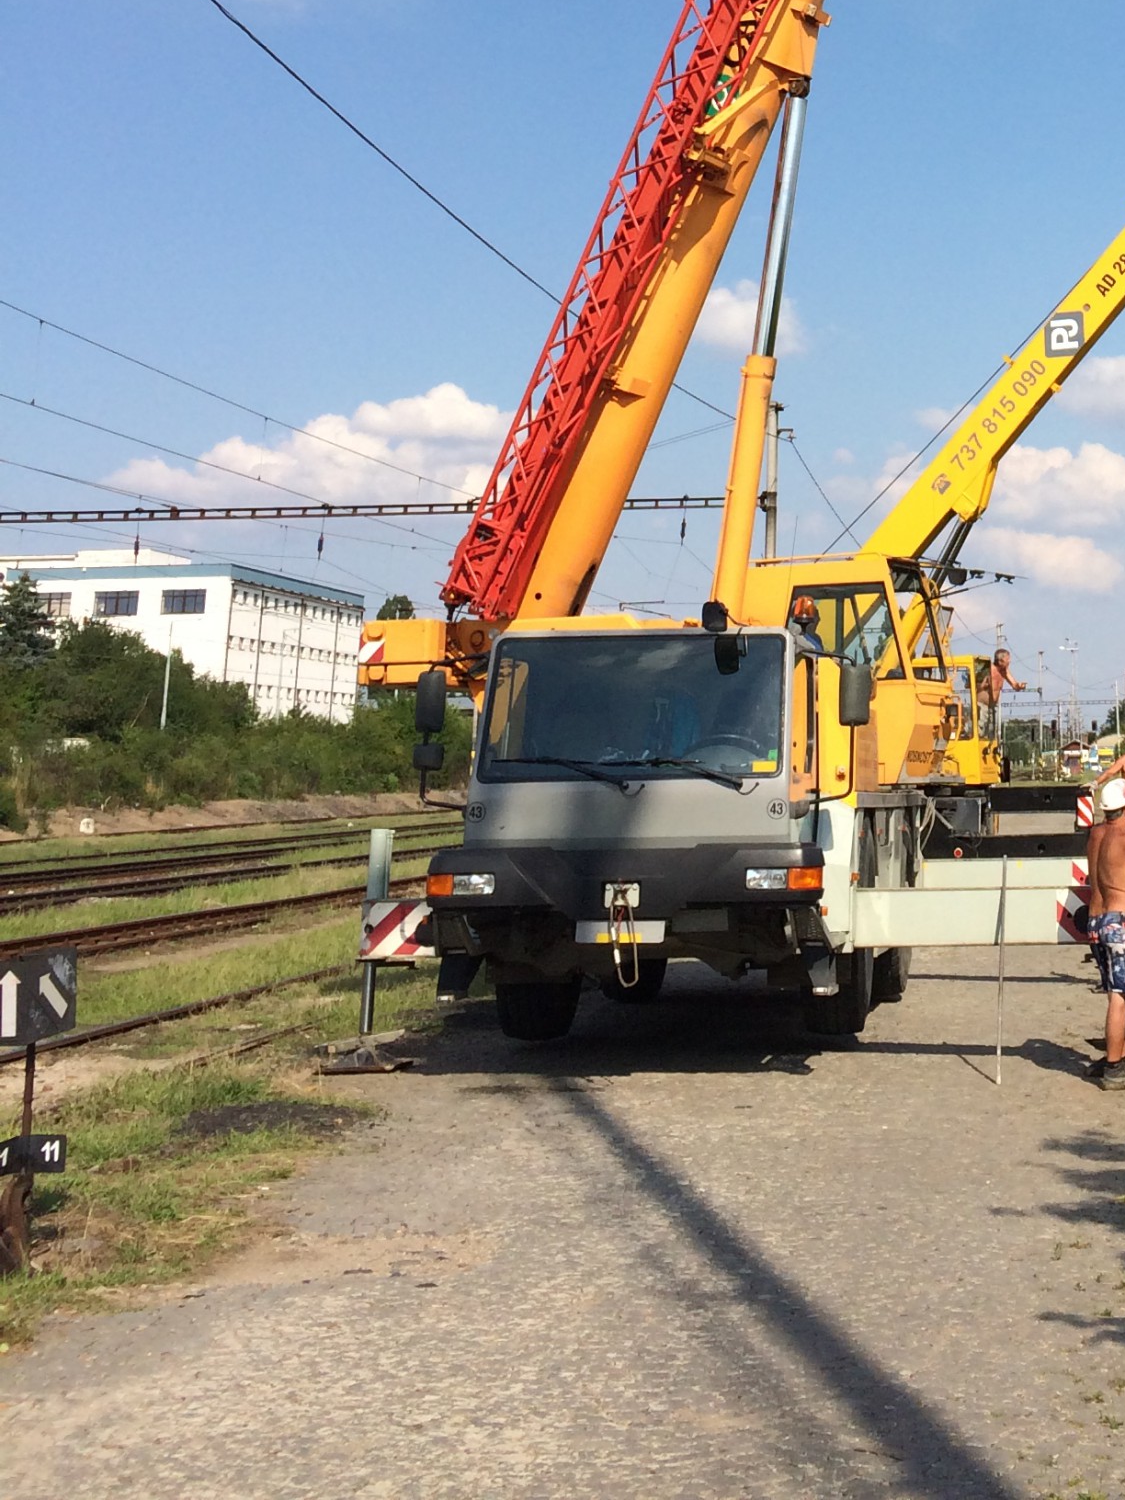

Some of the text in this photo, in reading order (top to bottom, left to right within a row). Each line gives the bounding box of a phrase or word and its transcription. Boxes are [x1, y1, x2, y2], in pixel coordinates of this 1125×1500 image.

[1096, 274, 1116, 297] AD
[950, 359, 1046, 471] 737 815 090
[469, 806, 482, 819] 43
[770, 802, 783, 815] 43
[40, 1140, 60, 1162] 11
